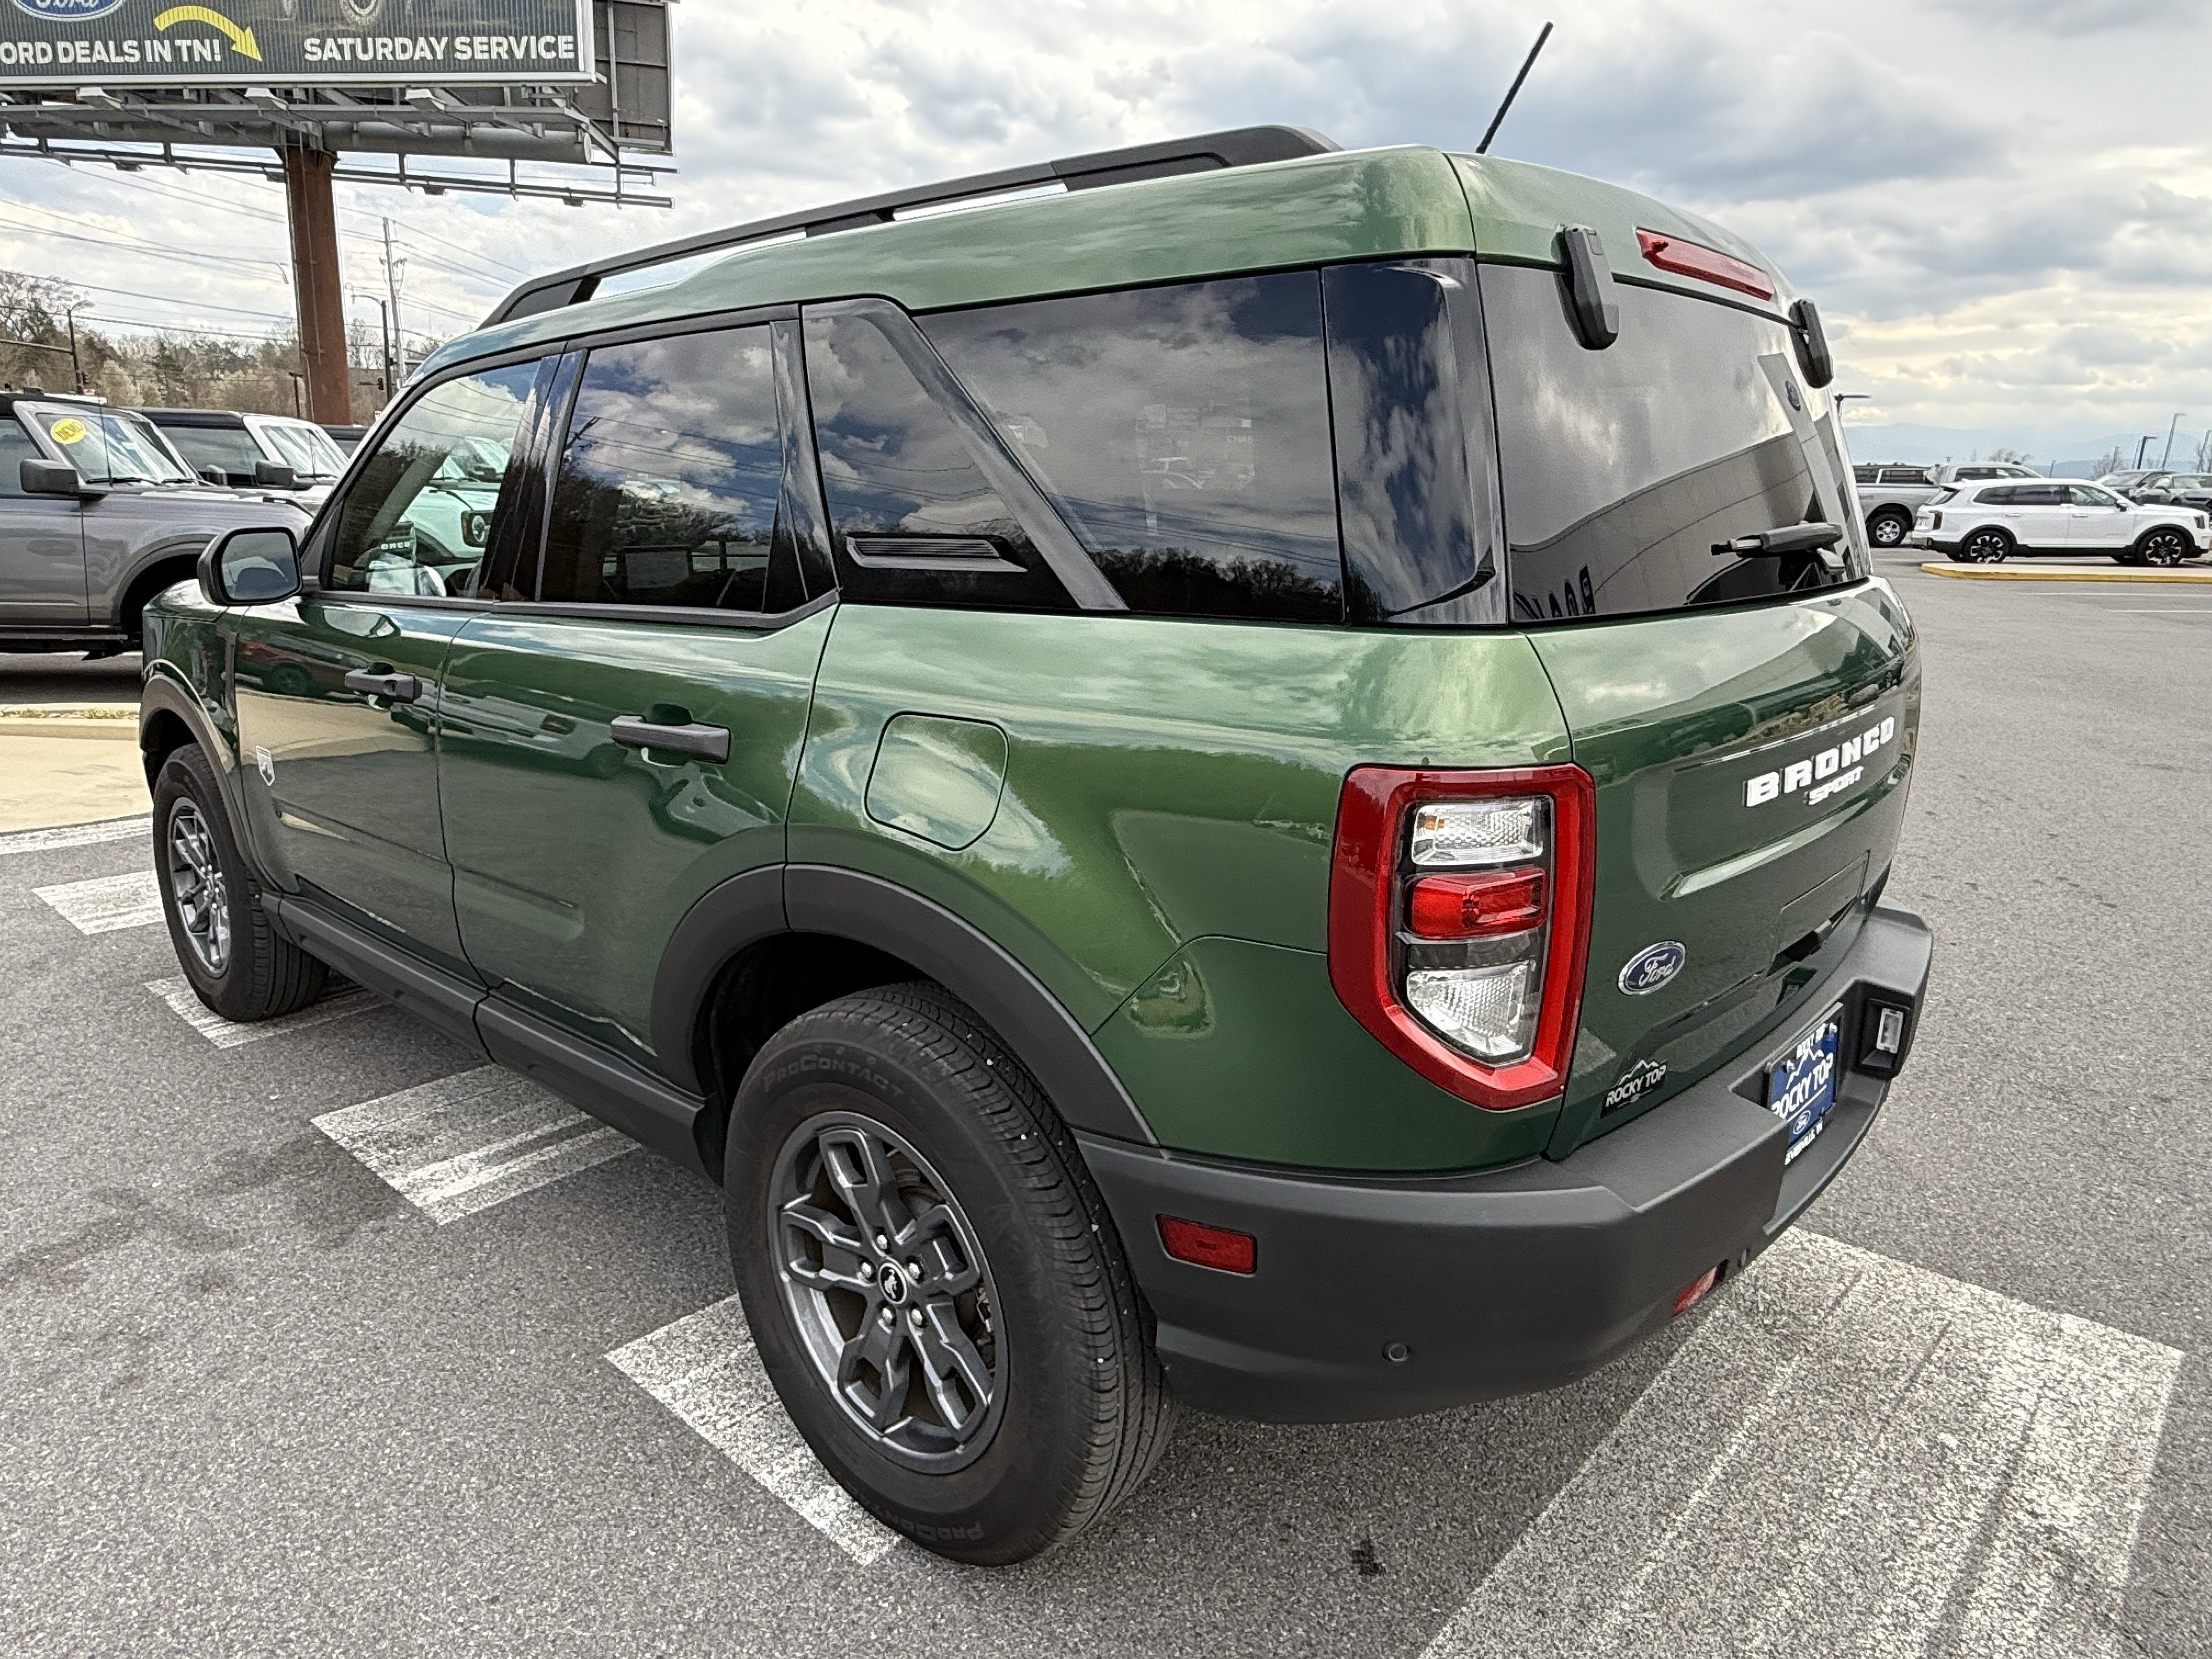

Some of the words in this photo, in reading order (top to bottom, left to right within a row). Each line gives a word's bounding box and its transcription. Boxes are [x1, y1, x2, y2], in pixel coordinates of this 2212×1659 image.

[57, 41, 138, 64] DEALS
[145, 40, 172, 62] IN
[175, 39, 222, 61] TN!
[304, 37, 448, 61] SATURDAY
[454, 36, 575, 59] SERVICE
[55, 421, 83, 441] DEMO
[1745, 716, 1895, 808] BRONCO
[1807, 766, 1864, 805] SPORT
[1605, 1075, 1645, 1107] ROCKY
[1646, 1065, 1667, 1087] TOP
[1771, 1072, 1813, 1120] ROCKY
[1813, 1052, 1833, 1091] TOP
